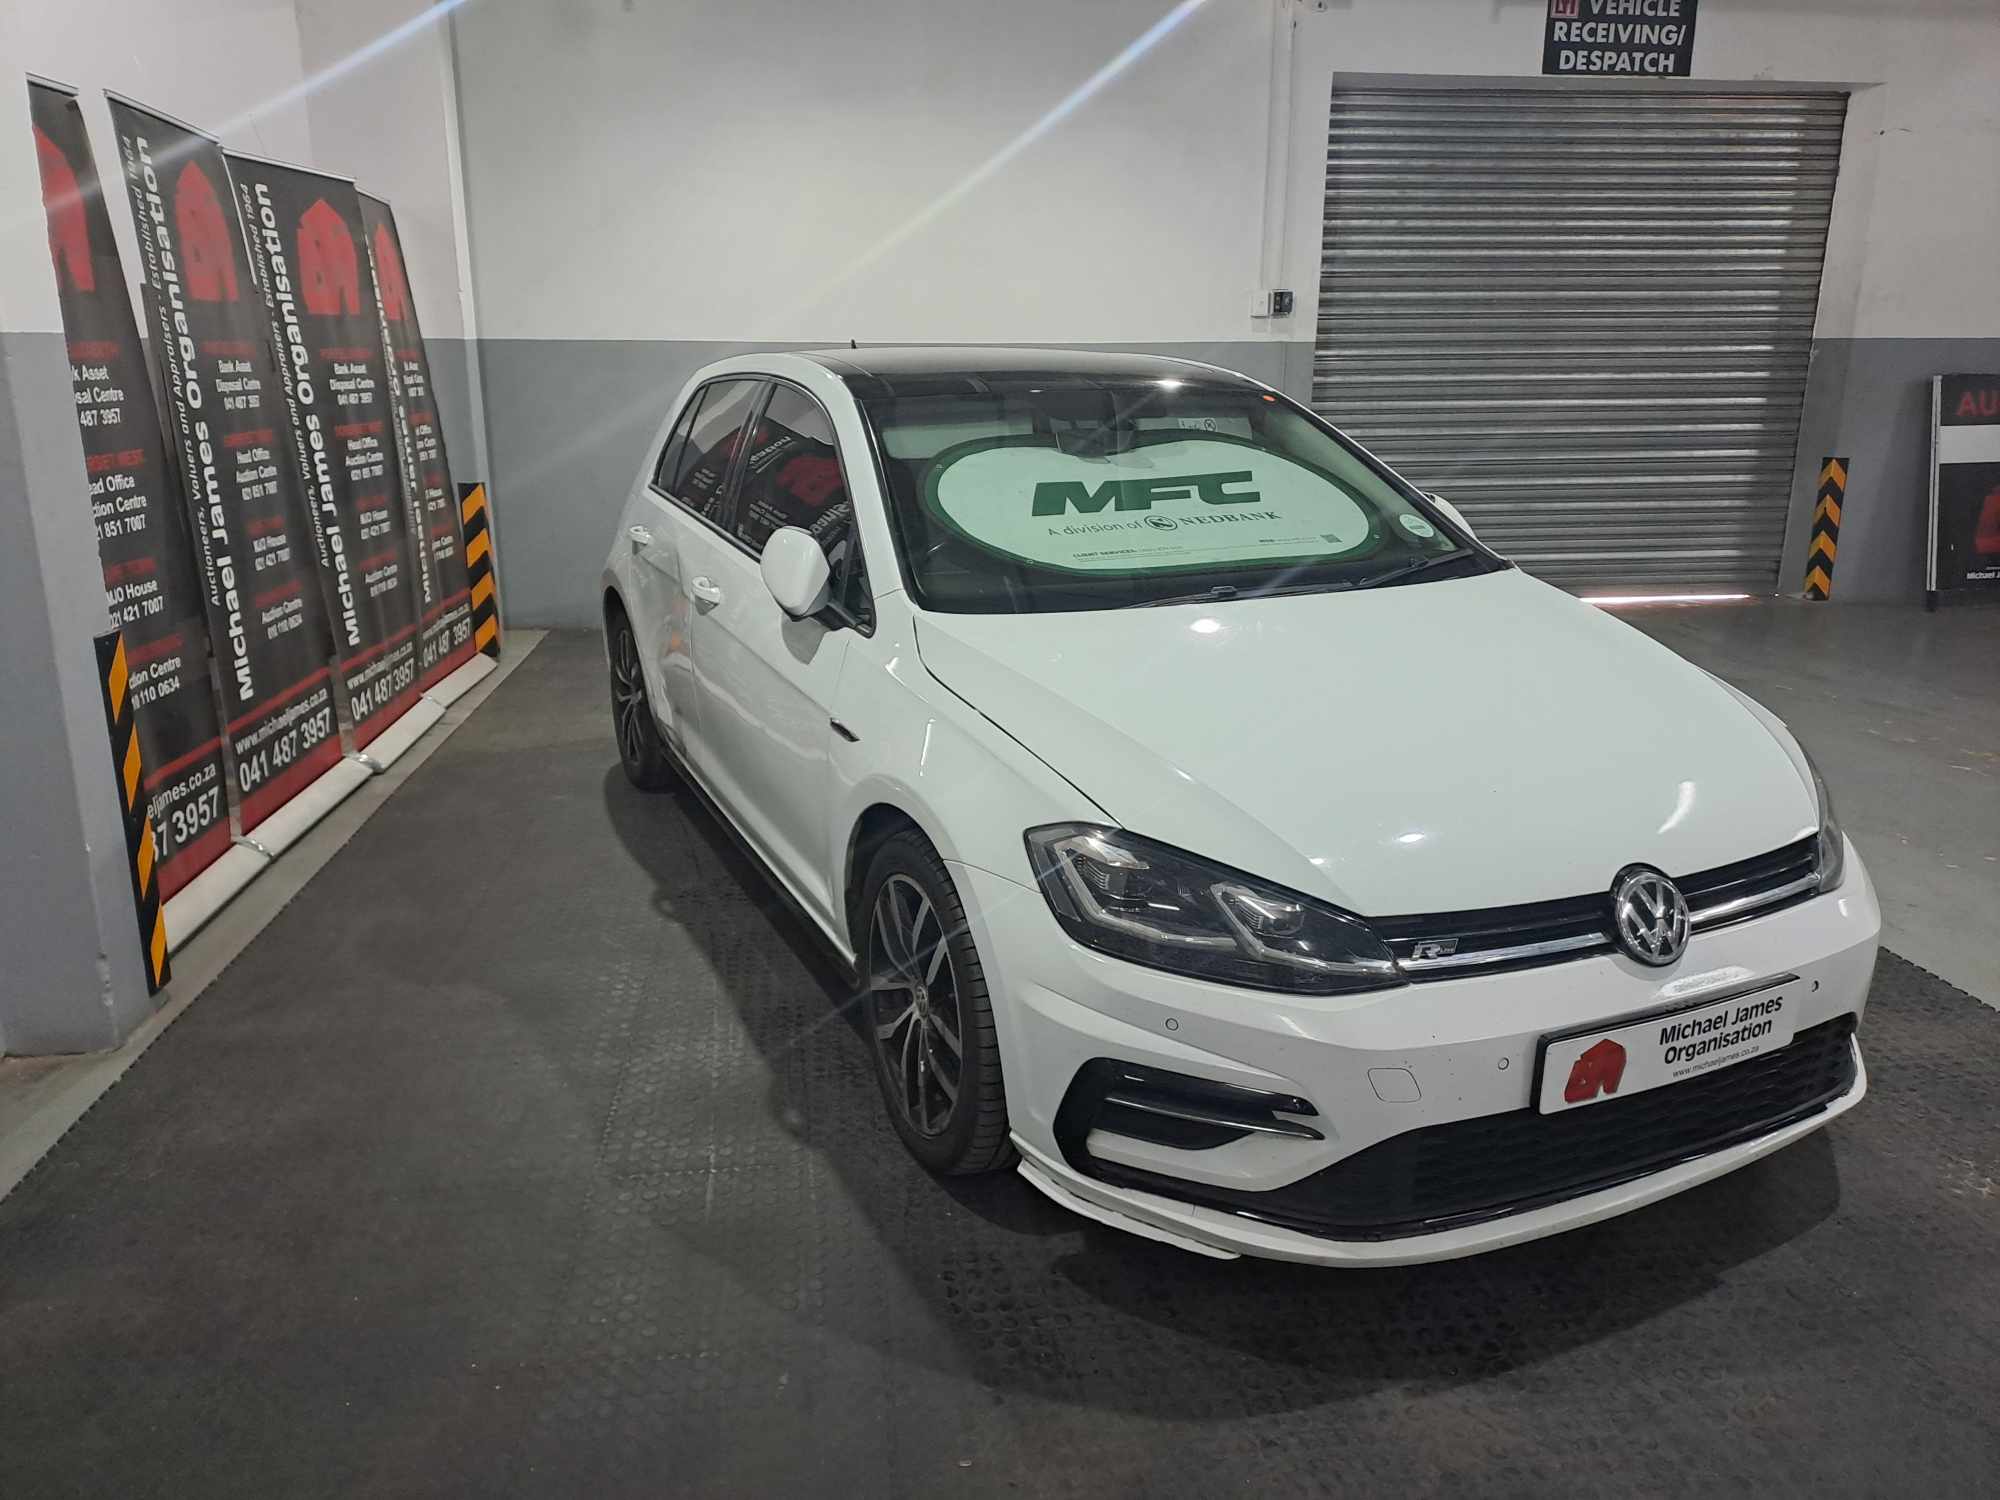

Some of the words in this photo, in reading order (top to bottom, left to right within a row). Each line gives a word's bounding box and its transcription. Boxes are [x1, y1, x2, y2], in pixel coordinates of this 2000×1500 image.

[1590, 0, 1681, 17] VEHICLE
[1559, 49, 1676, 73] DESPATCH
[130, 184, 163, 290] Established
[136, 136, 203, 410] Organisation
[247, 223, 275, 309] Established
[254, 182, 315, 405] Organisation
[82, 364, 109, 381] Asset
[159, 306, 183, 400] Appraisers
[271, 321, 293, 396] Appraisers
[93, 386, 124, 403] Centre
[175, 400, 190, 434] and
[285, 398, 300, 426] and
[184, 438, 201, 500] Valuers
[295, 430, 311, 480] Valuers
[305, 414, 338, 517] James
[105, 474, 136, 492] Office
[115, 495, 147, 513] Centre
[194, 421, 229, 545] James
[1032, 470, 1261, 517] MFC
[104, 520, 123, 538] 851
[1063, 521, 1124, 536] division
[1126, 519, 1144, 531] of
[1178, 510, 1282, 527] NEDBANK
[125, 580, 158, 599] House
[326, 526, 360, 647] Michael
[123, 603, 141, 622] 421
[216, 556, 254, 701] Michael
[149, 656, 182, 679] Centre
[350, 688, 374, 721] 041
[374, 673, 392, 704] 487
[393, 657, 415, 691] 3957
[239, 759, 270, 793] 041
[272, 729, 298, 768] 487
[300, 706, 332, 749] 3957
[171, 785, 220, 844] 3957
[1658, 1009, 1729, 1046] Michael
[1731, 995, 1784, 1026] James
[1663, 1018, 1773, 1065] Organisation
